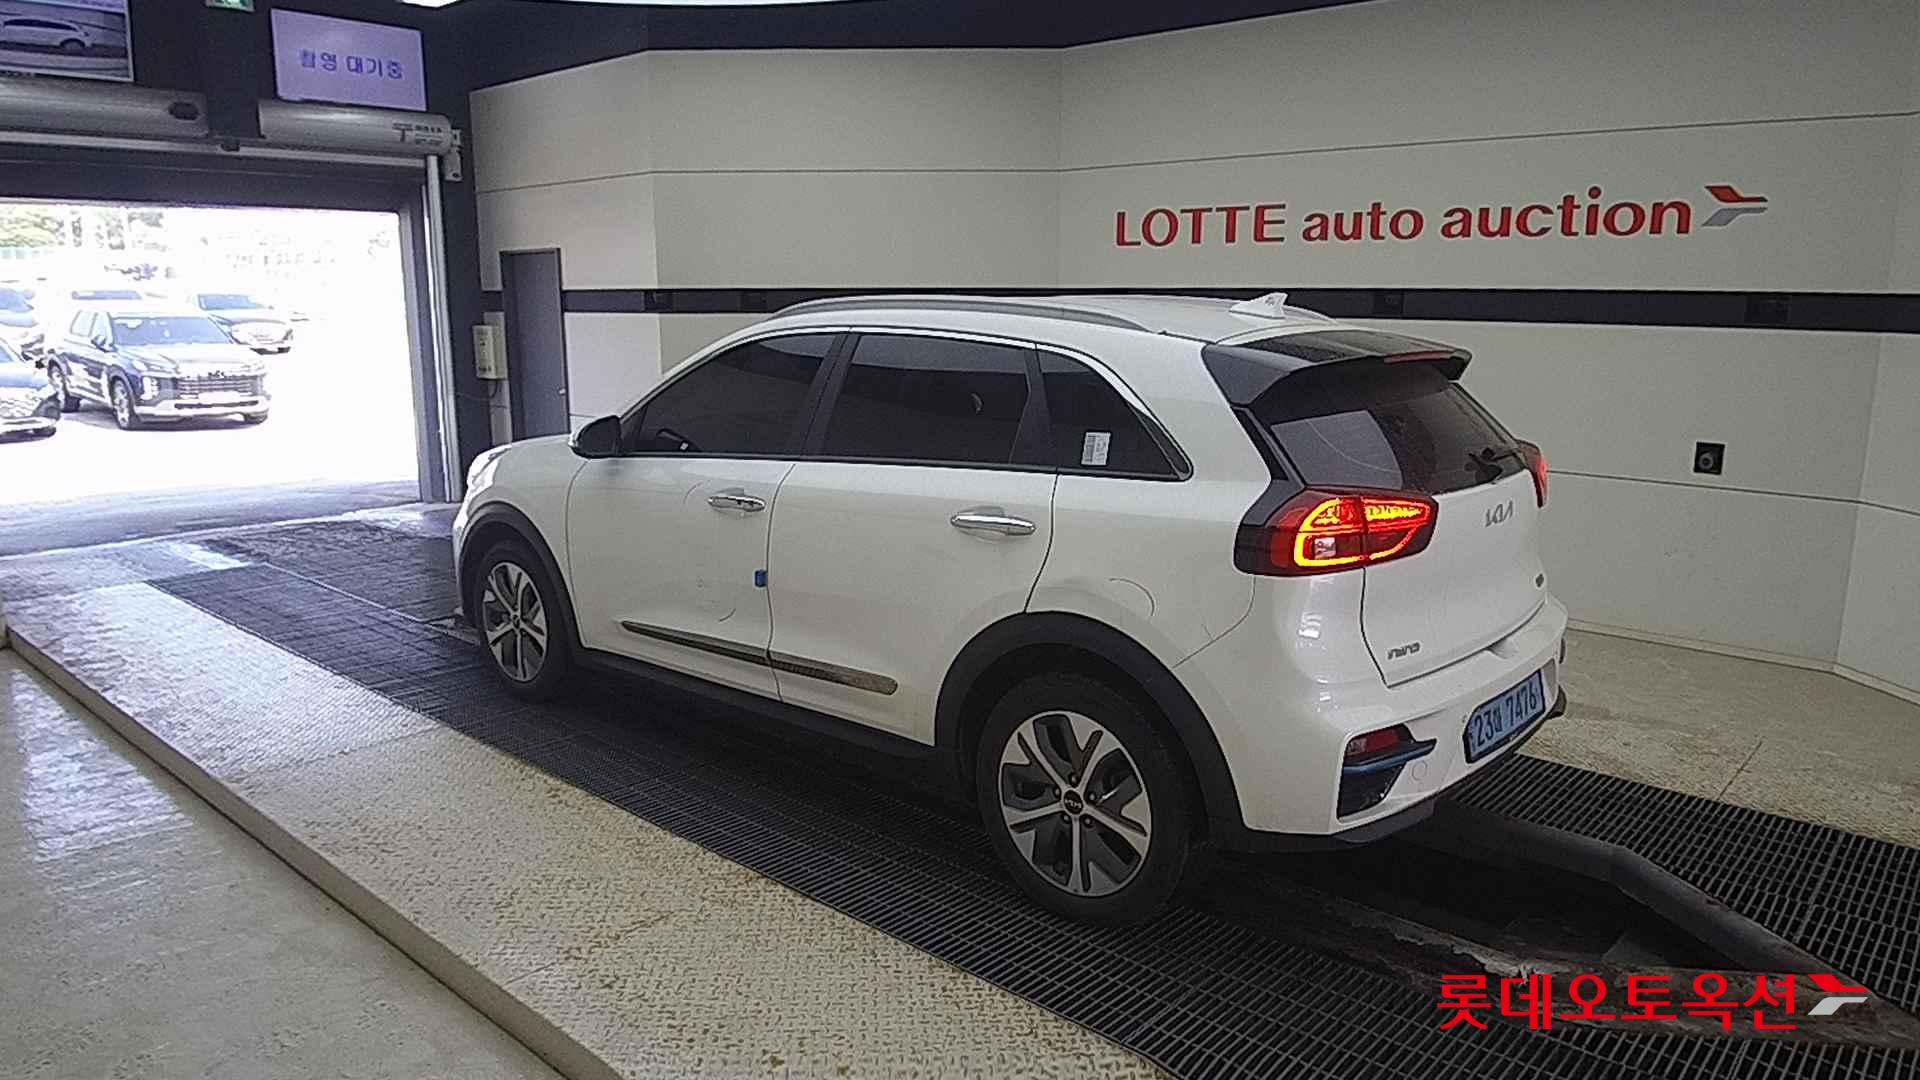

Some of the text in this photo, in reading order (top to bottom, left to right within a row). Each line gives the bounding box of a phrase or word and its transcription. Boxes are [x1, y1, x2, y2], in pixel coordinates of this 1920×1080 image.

[1116, 187, 1692, 247] LOTTE auto auction
[1505, 681, 1539, 726] 7476
